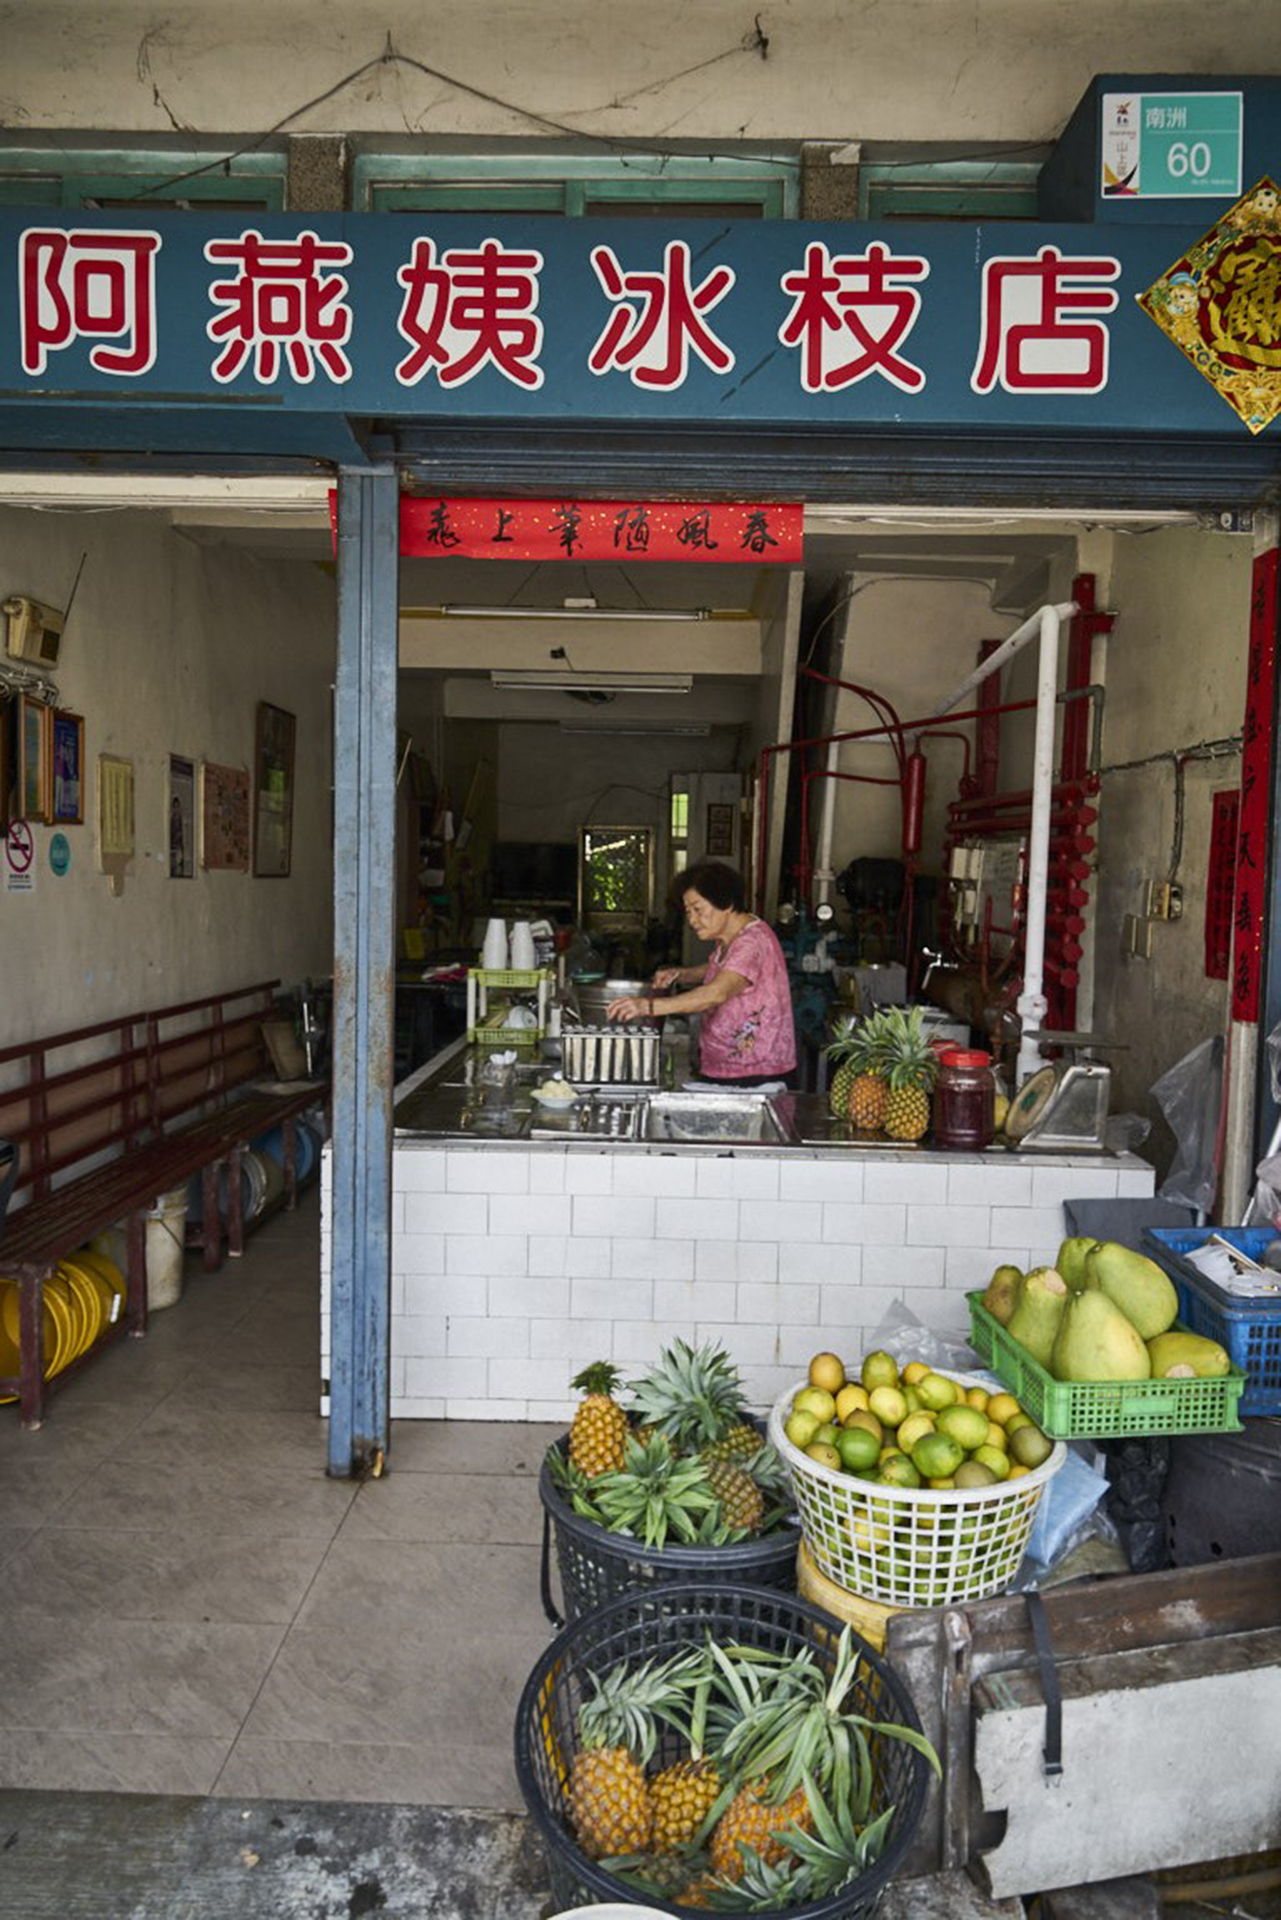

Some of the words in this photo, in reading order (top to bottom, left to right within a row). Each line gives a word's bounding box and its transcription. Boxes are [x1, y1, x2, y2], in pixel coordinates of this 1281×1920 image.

[1146, 106, 1187, 129] 南洲
[1167, 142, 1211, 177] 60
[20, 228, 1123, 394] 阿燕姨冰枝店
